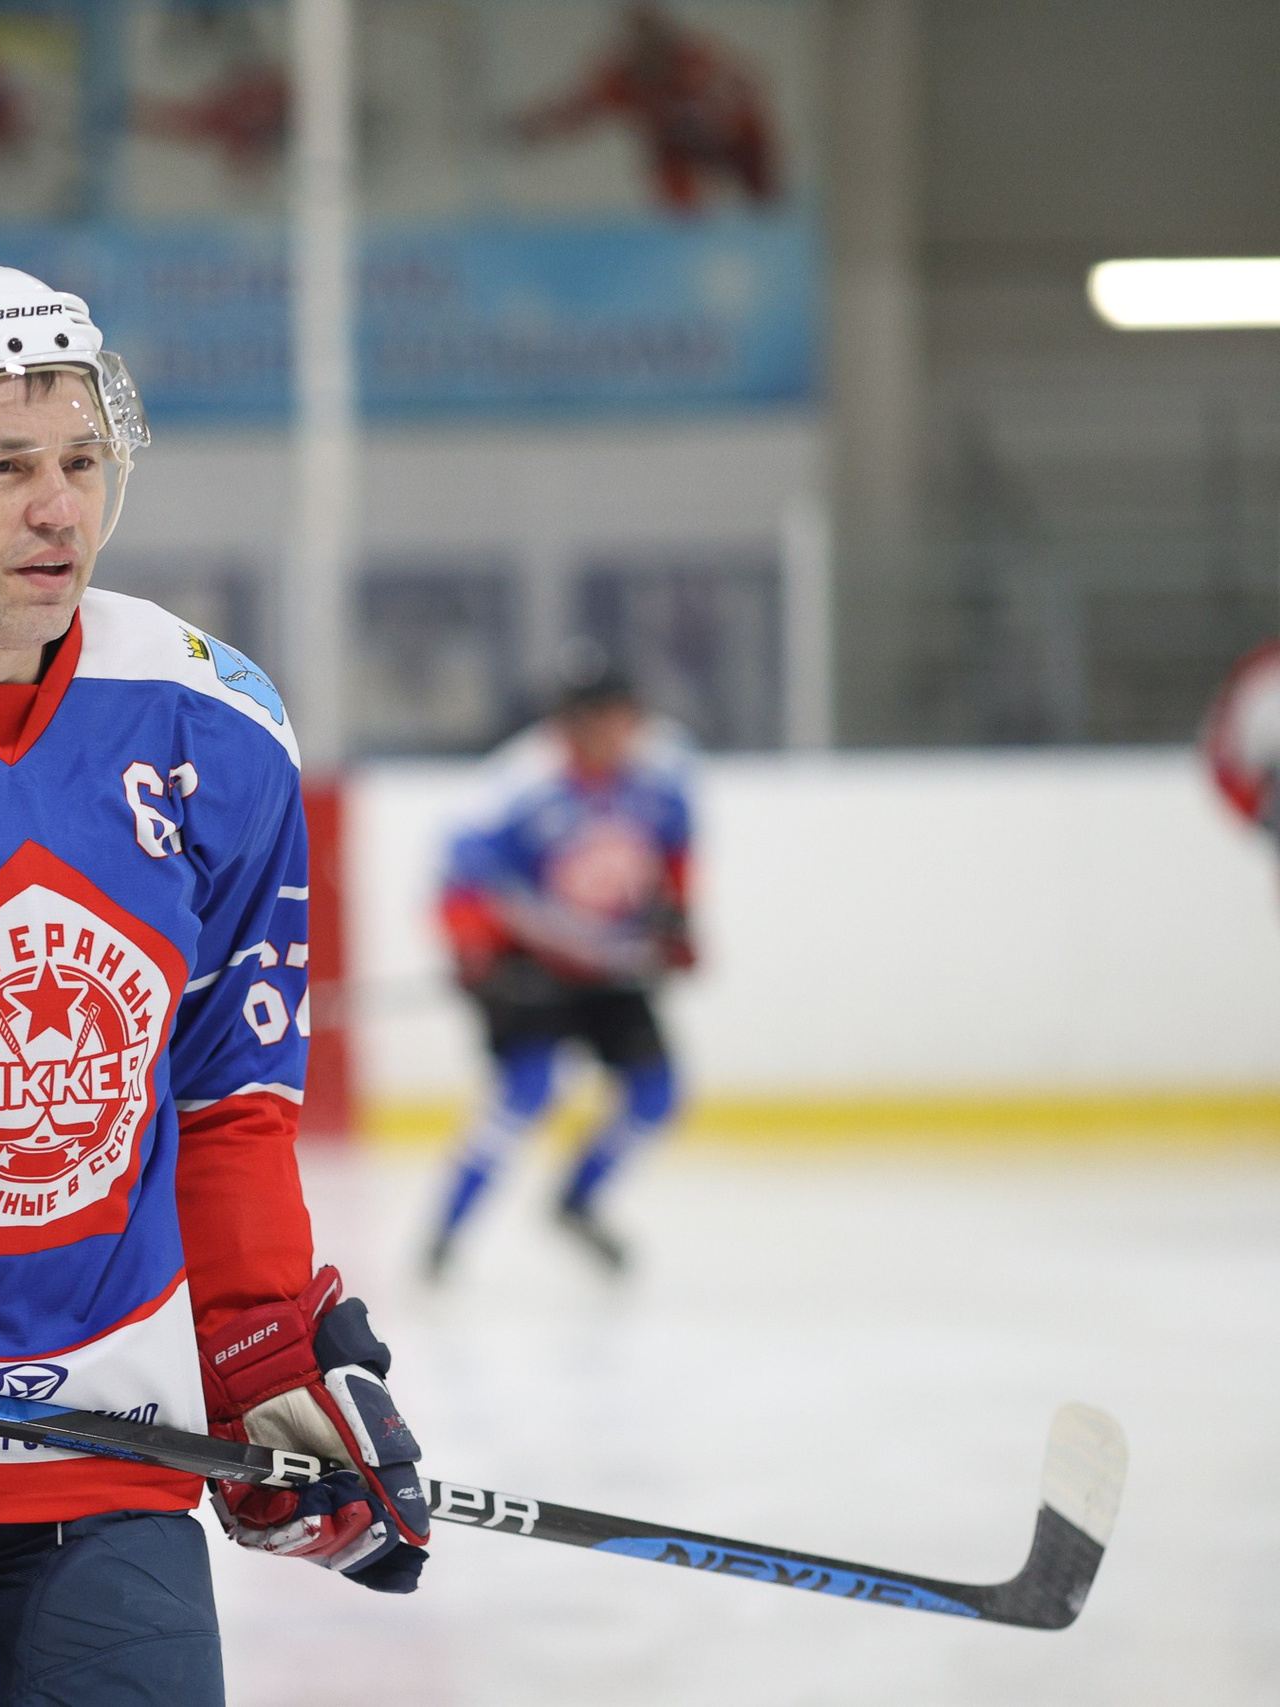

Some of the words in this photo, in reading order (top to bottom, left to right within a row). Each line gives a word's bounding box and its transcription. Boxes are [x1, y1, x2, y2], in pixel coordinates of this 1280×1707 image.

[69, 1174, 80, 1198] В
[89, 1109, 135, 1175] СССР
[214, 1321, 279, 1366] BAUER
